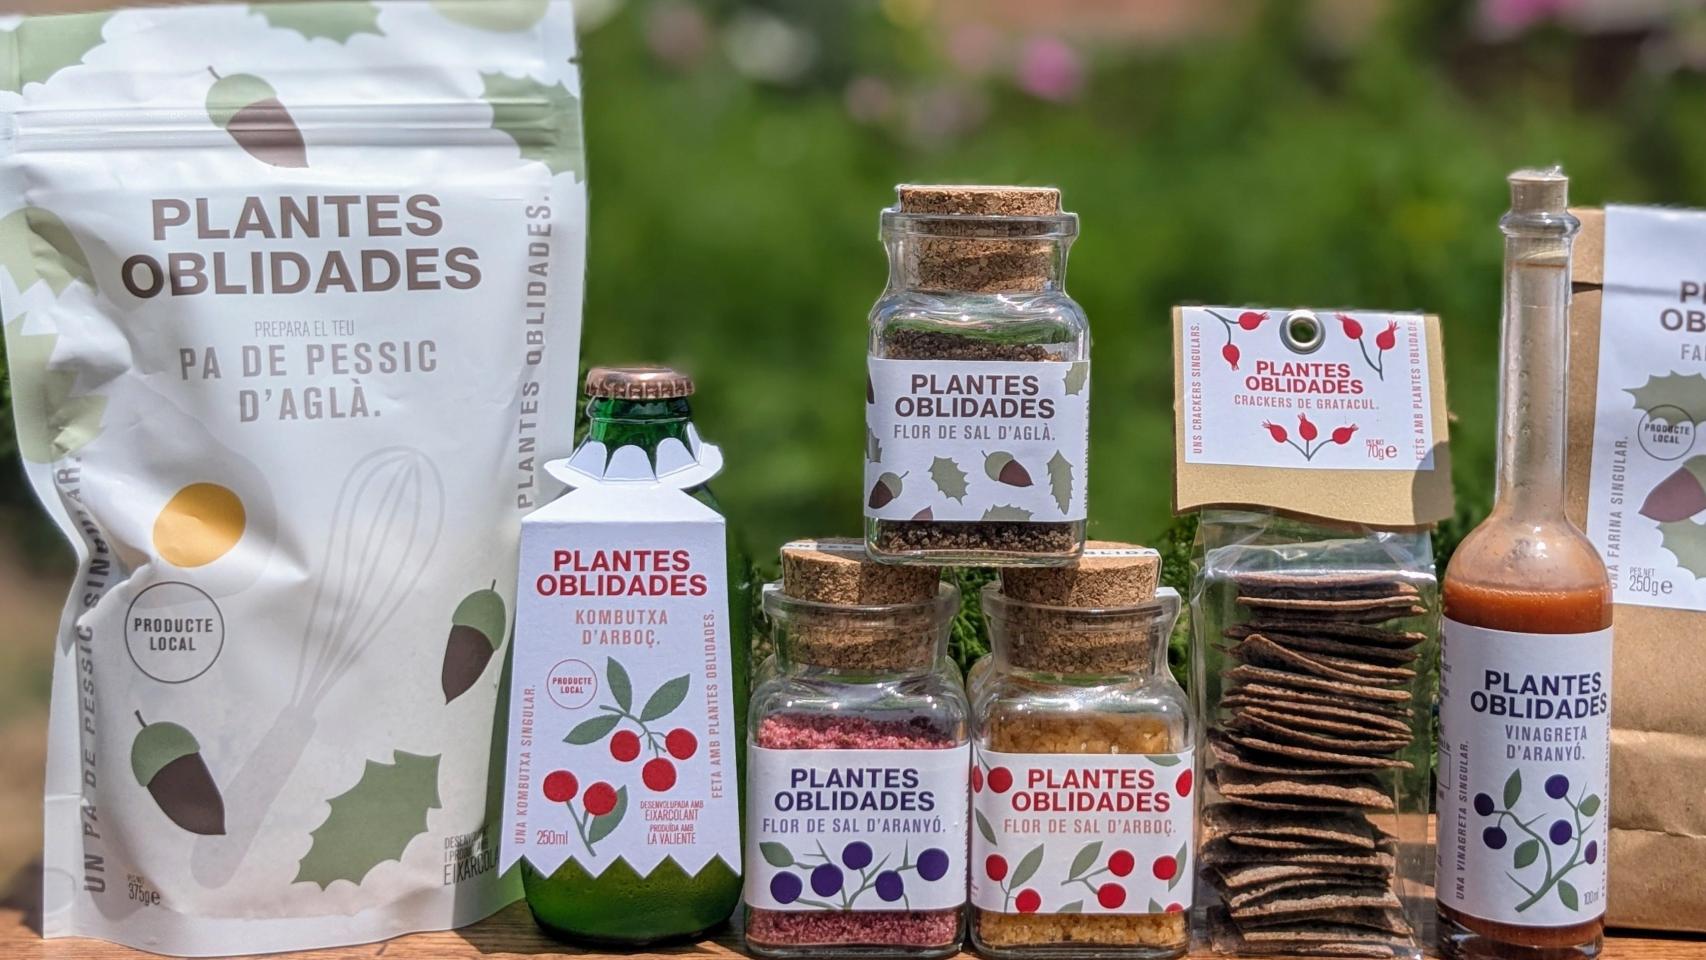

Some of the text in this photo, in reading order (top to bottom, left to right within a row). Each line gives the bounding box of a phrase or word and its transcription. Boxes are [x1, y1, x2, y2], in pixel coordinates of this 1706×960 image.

[151, 194, 444, 241] PLANTES
[121, 247, 482, 299] OBLIDADES
[254, 319, 355, 338] PREPARA EL TEU
[179, 340, 438, 381] PA DE PESSIC
[517, 195, 553, 510] PLANTES OBLIDADES.
[1681, 343, 1706, 361] FA
[1256, 360, 1351, 378] PLANTES
[911, 374, 1039, 396] PLANTES
[1245, 376, 1364, 395] OBLIDADES
[1411, 368, 1422, 409] PLANTES
[239, 378, 381, 423] D'AGLÀ.
[895, 396, 1056, 419] OBLIDADES
[1192, 381, 1202, 431] CRACKERS
[1234, 394, 1379, 410] CRACKERS DE GRATACUL.
[894, 422, 1056, 441] FLOR DE SAL D'AGLÀ.
[1414, 413, 1424, 434] AMB
[1644, 423, 1690, 436] PRODUCTE
[1193, 434, 1203, 454] UNS
[1653, 434, 1680, 445] LOCAL
[1610, 436, 1629, 505] SINGULAR.
[1607, 511, 1622, 559] FARINA
[554, 550, 690, 572] PLANTES
[536, 574, 708, 597] OBLIDADES
[134, 617, 214, 634] PRODUCTE
[575, 608, 668, 625] KOMBUTXA
[149, 636, 198, 652] LOCAL
[582, 629, 660, 648] D'ARBOÇ.
[77, 623, 97, 735] PESSIC
[552, 677, 593, 685] PRODUCTE
[1485, 669, 1602, 696] PLANTES
[560, 686, 584, 694] LOCAL
[703, 609, 723, 799] FETA AMB PLANTES OBLIDADES.
[1470, 690, 1607, 719] OBLIDADES
[1505, 724, 1588, 742] VINAGRETA
[1506, 742, 1585, 761] D'ARANYÓ.
[84, 750, 98, 789] DE
[514, 684, 536, 845] UNA KOMBUTXA SINGULAR.
[791, 768, 919, 788] PLANTES
[1028, 769, 1155, 789] PLANTES
[691, 799, 705, 809] AMB
[774, 791, 935, 812] OBLIDADES
[1011, 791, 1171, 812] OBLIDADES
[84, 805, 102, 839] PA
[645, 809, 699, 821] EIXARCOLANT
[763, 815, 946, 833] FLOR DE SAL D'ARANYÓ.
[536, 829, 568, 845] 250ml
[681, 823, 694, 832] AMB
[1004, 818, 1176, 838] FLOR DE SAL D'ARBOÇ.
[647, 832, 697, 845] LA VALIENTE
[1456, 807, 1468, 872] VINAGRETA
[84, 853, 106, 893] UN
[443, 845, 499, 886] EIXARCOL
[1456, 876, 1465, 900] UNA
